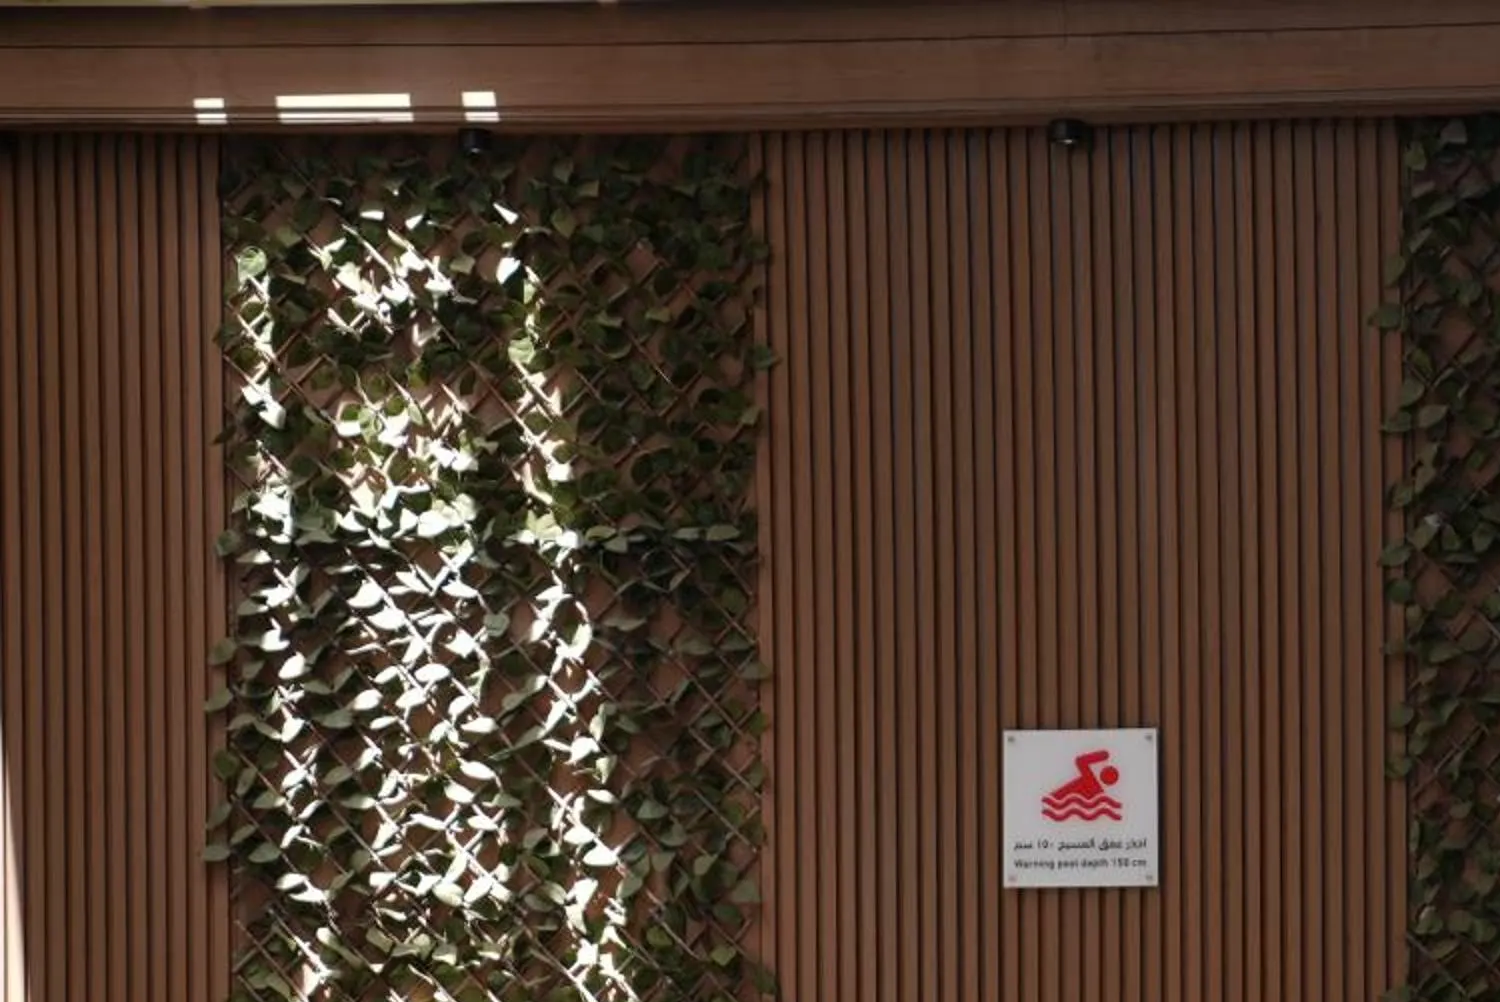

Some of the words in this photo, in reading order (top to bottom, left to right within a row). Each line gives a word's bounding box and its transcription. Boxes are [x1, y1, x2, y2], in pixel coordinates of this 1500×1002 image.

[1014, 859, 1055, 870] Warning
[1057, 859, 1079, 869] pool
[1081, 858, 1108, 869] depth
[1132, 860, 1147, 868] cm
